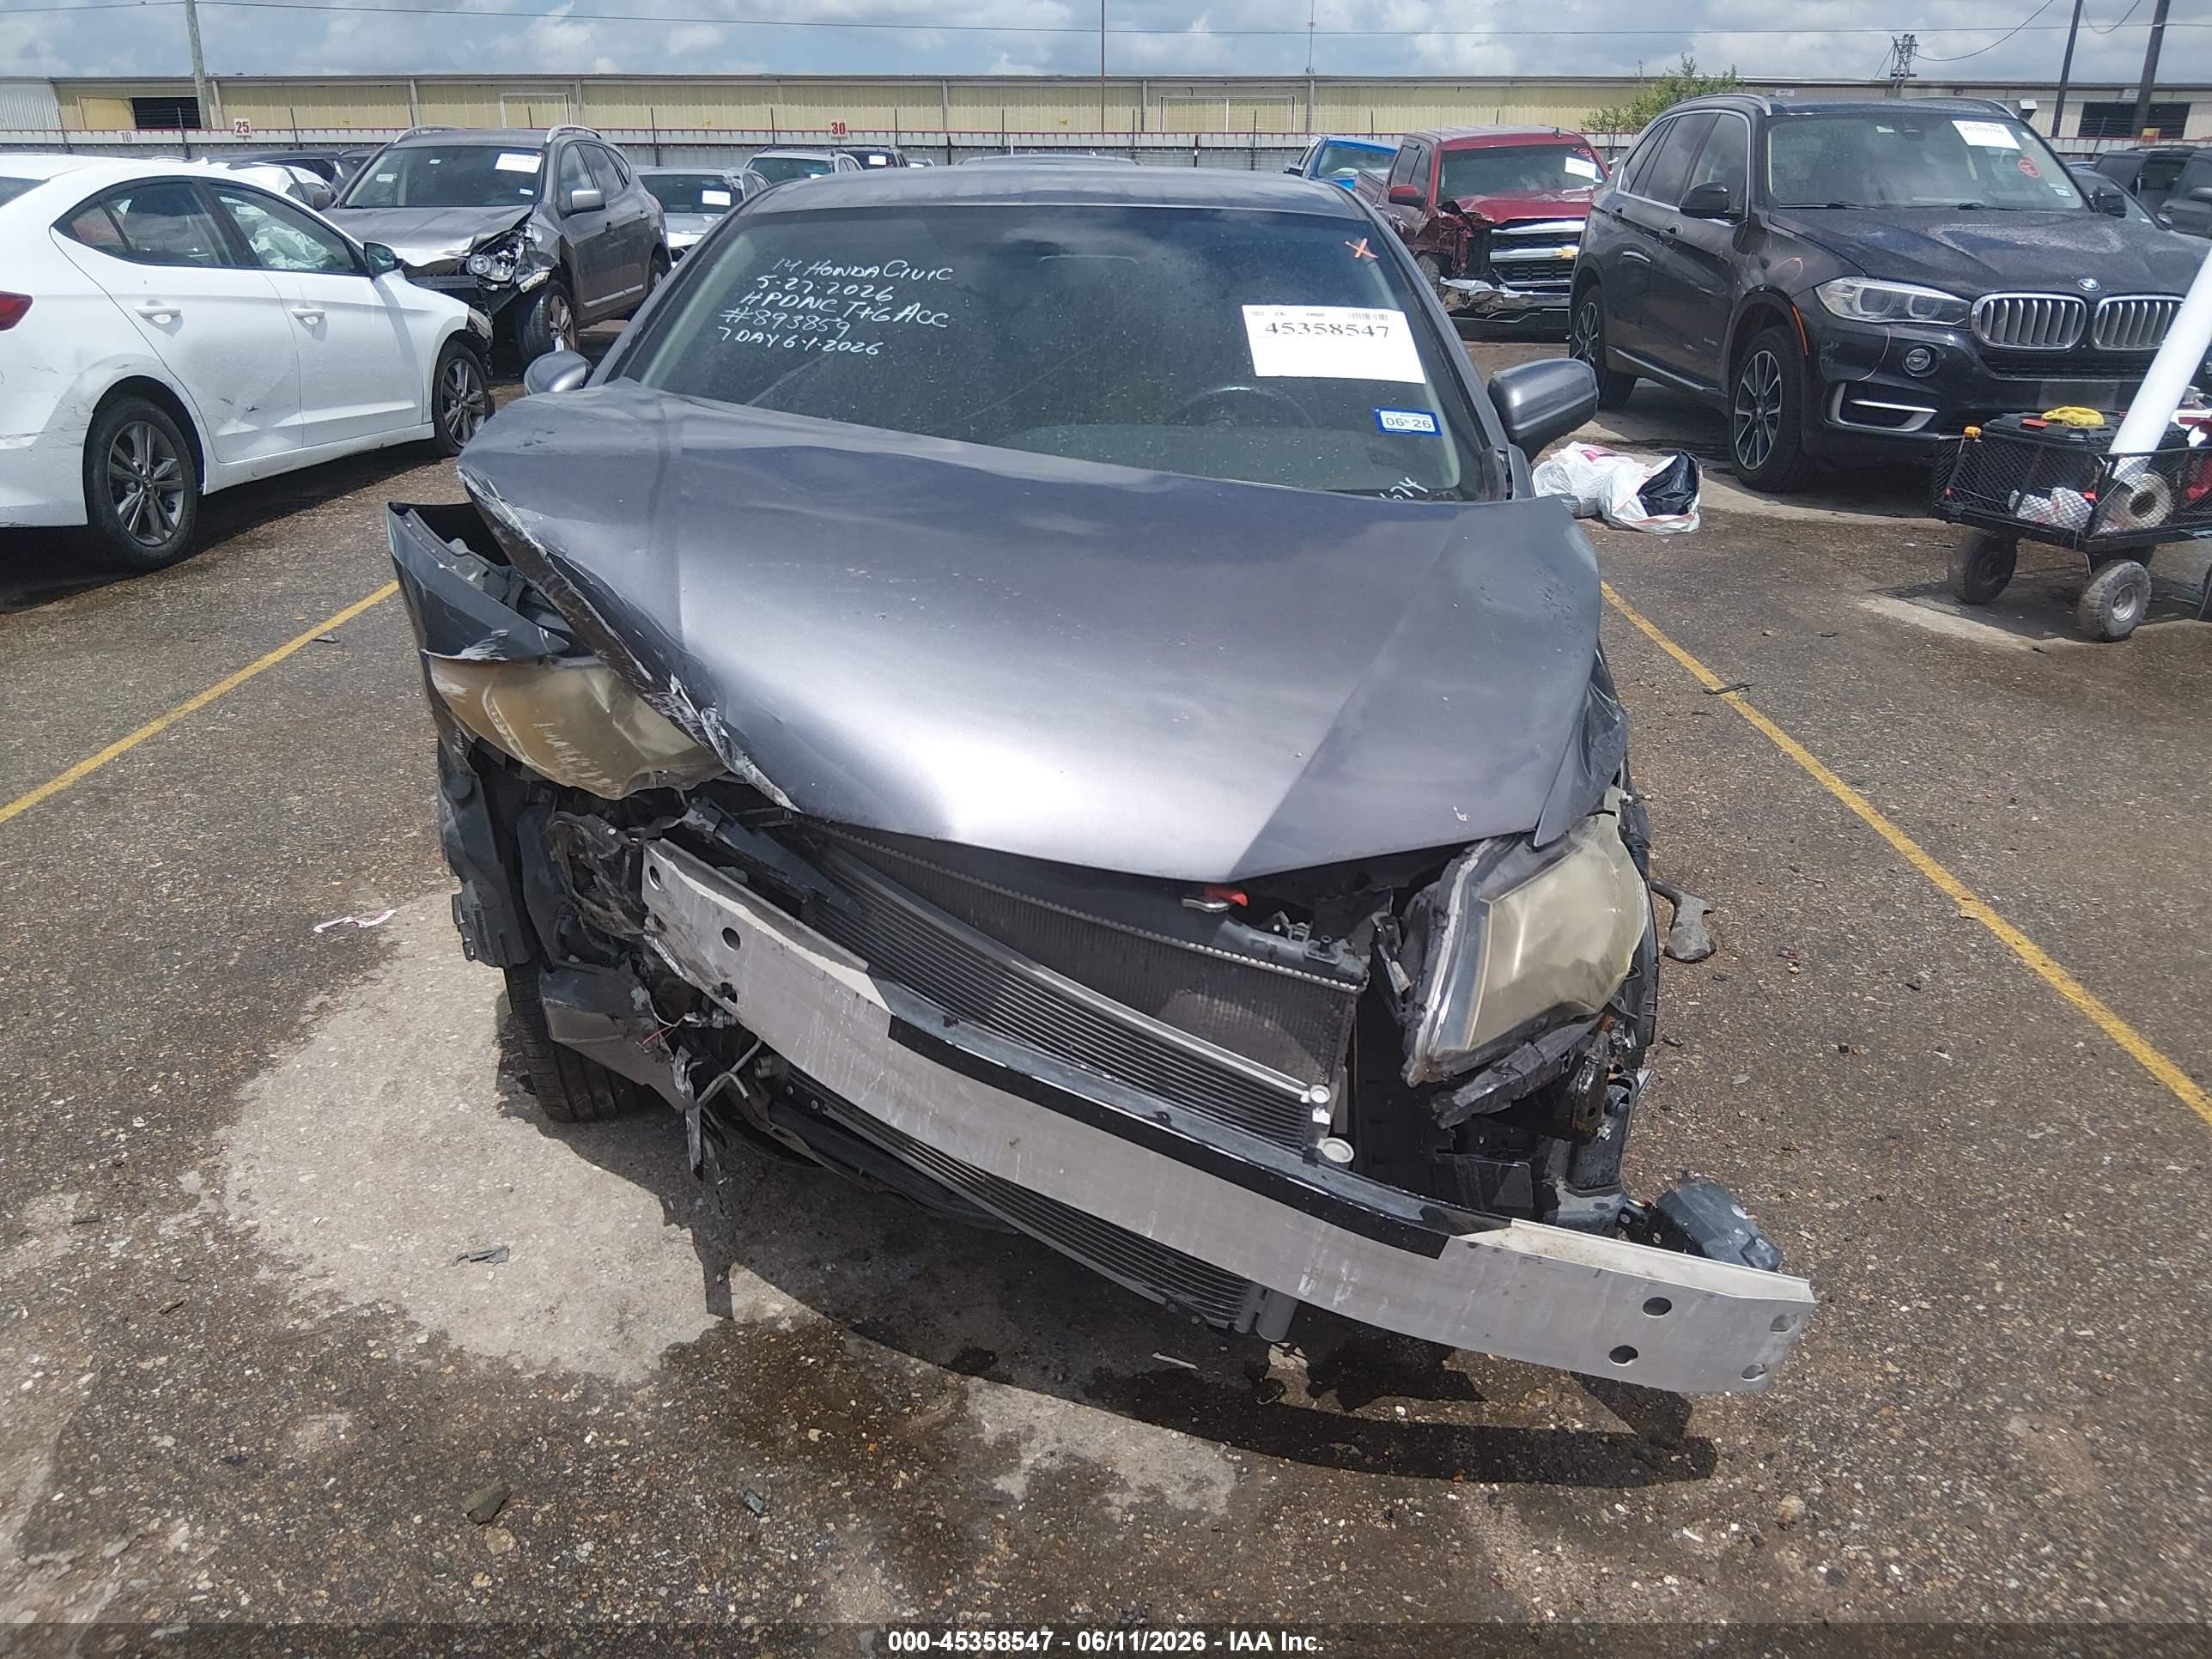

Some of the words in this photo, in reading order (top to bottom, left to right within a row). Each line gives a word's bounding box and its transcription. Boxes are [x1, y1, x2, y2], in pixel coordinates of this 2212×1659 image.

[235, 121, 249, 133] 25
[830, 122, 846, 135] 30
[120, 131, 133, 143] 10
[772, 258, 803, 273] 14
[803, 259, 880, 278] HONDA
[883, 259, 954, 282] CIVIC
[718, 306, 851, 341] #893859
[892, 301, 950, 328] ACC
[734, 329, 781, 349] DAY
[1265, 322, 1389, 338] 45358547
